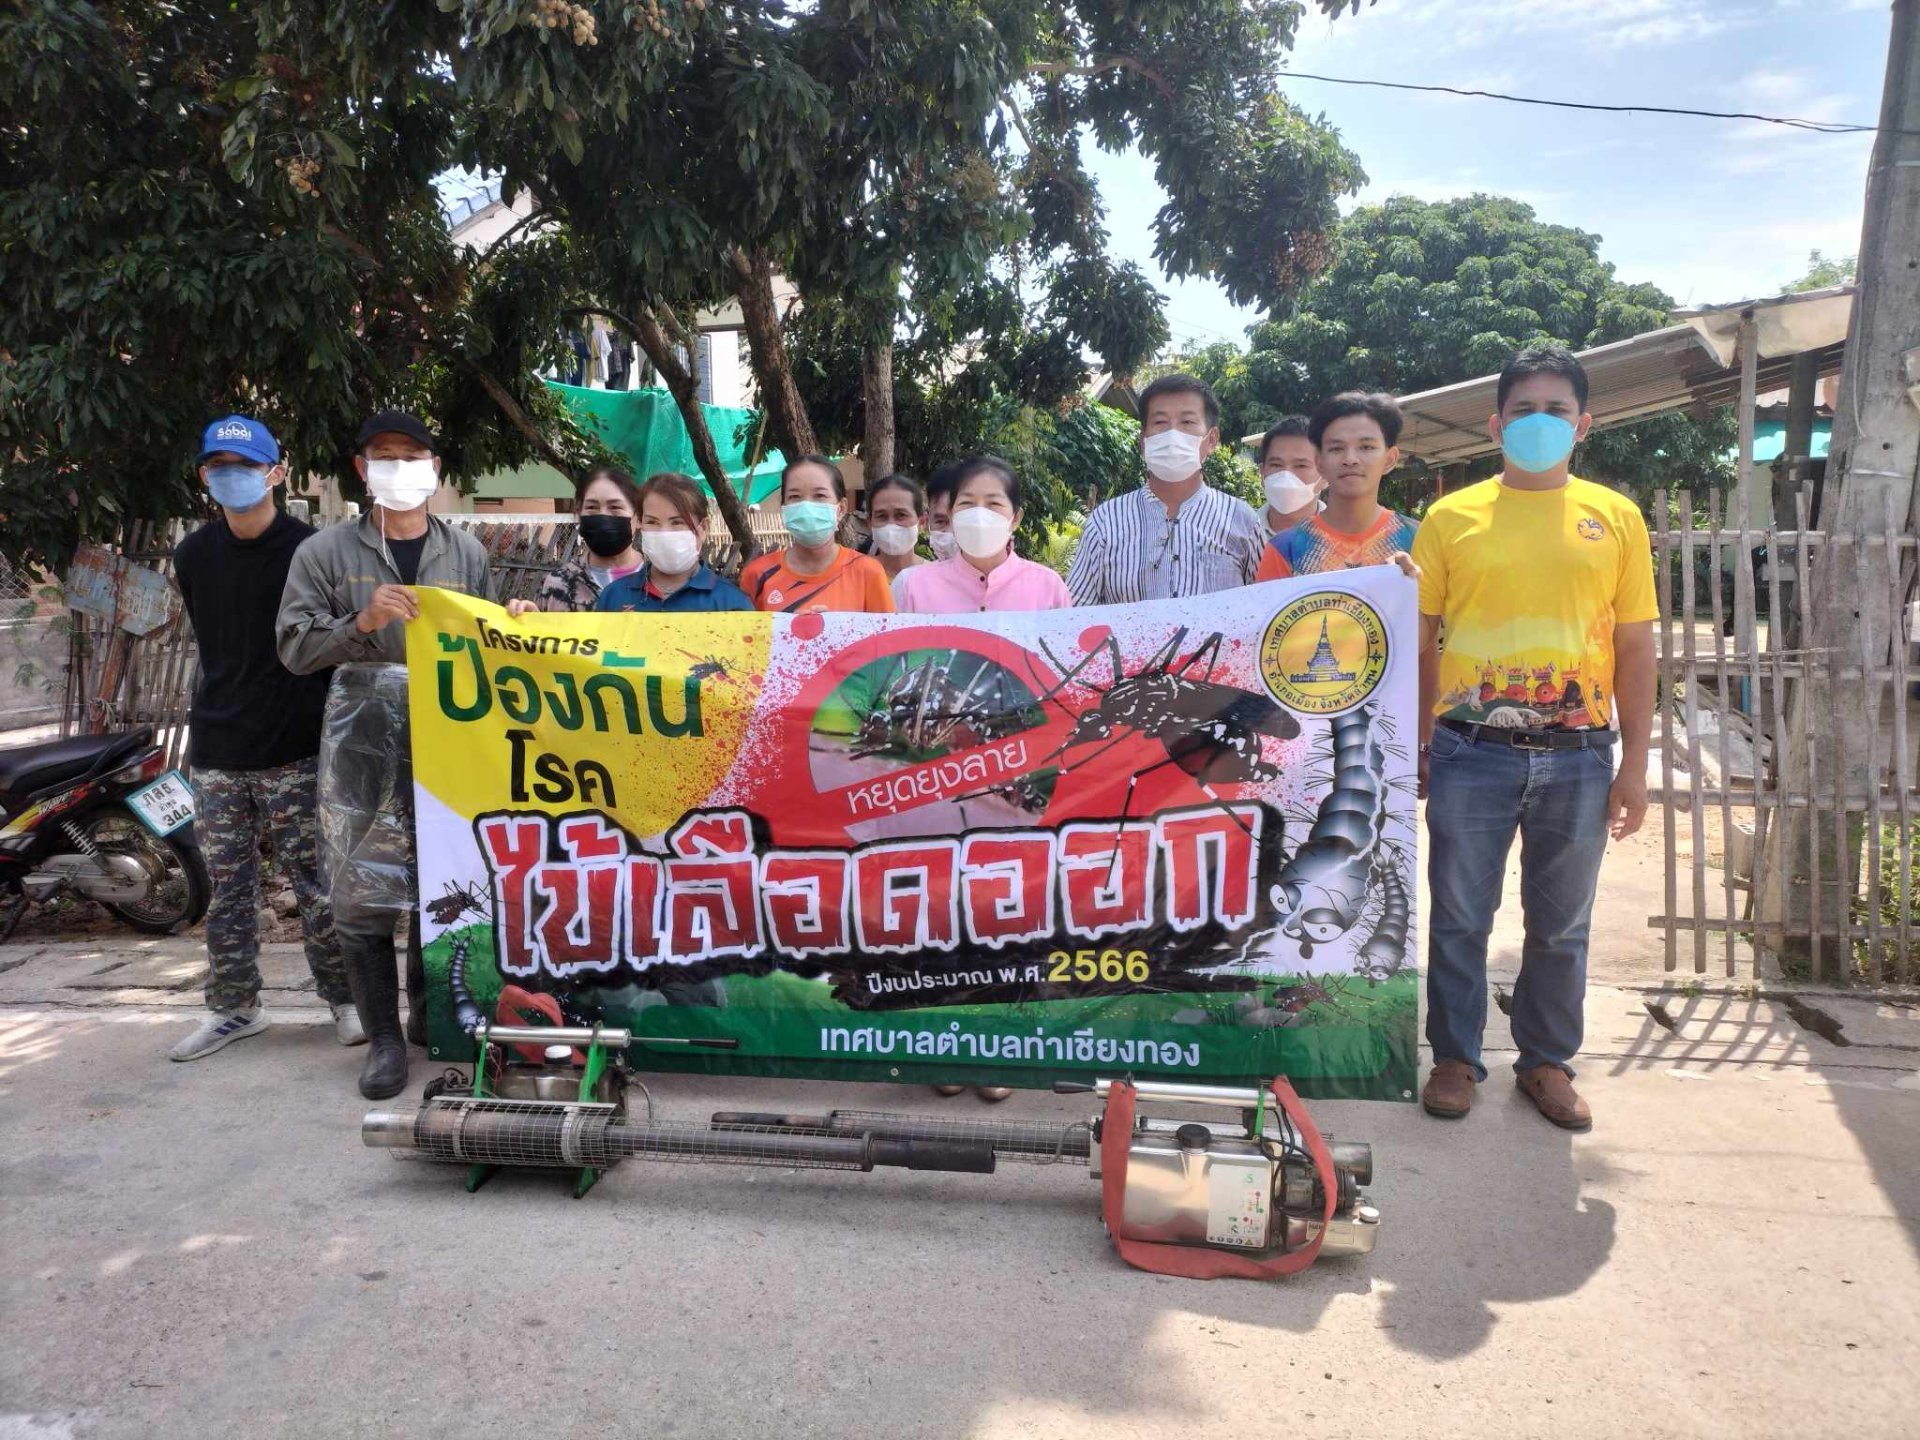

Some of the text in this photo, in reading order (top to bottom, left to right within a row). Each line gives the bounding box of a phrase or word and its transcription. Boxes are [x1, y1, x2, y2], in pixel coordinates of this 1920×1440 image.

[476, 617, 599, 656] โครงการ
[437, 632, 704, 737] ป้องกัน
[505, 729, 616, 808] โรค
[847, 740, 1027, 814] หยุดยุงลาย
[163, 804, 192, 826] 344
[477, 804, 1261, 977] ไข้เลือดออก
[867, 968, 992, 995] ปีงบประมาณ
[821, 1022, 1200, 1067] เทศบาลตำบลท่าเชียงทอง
